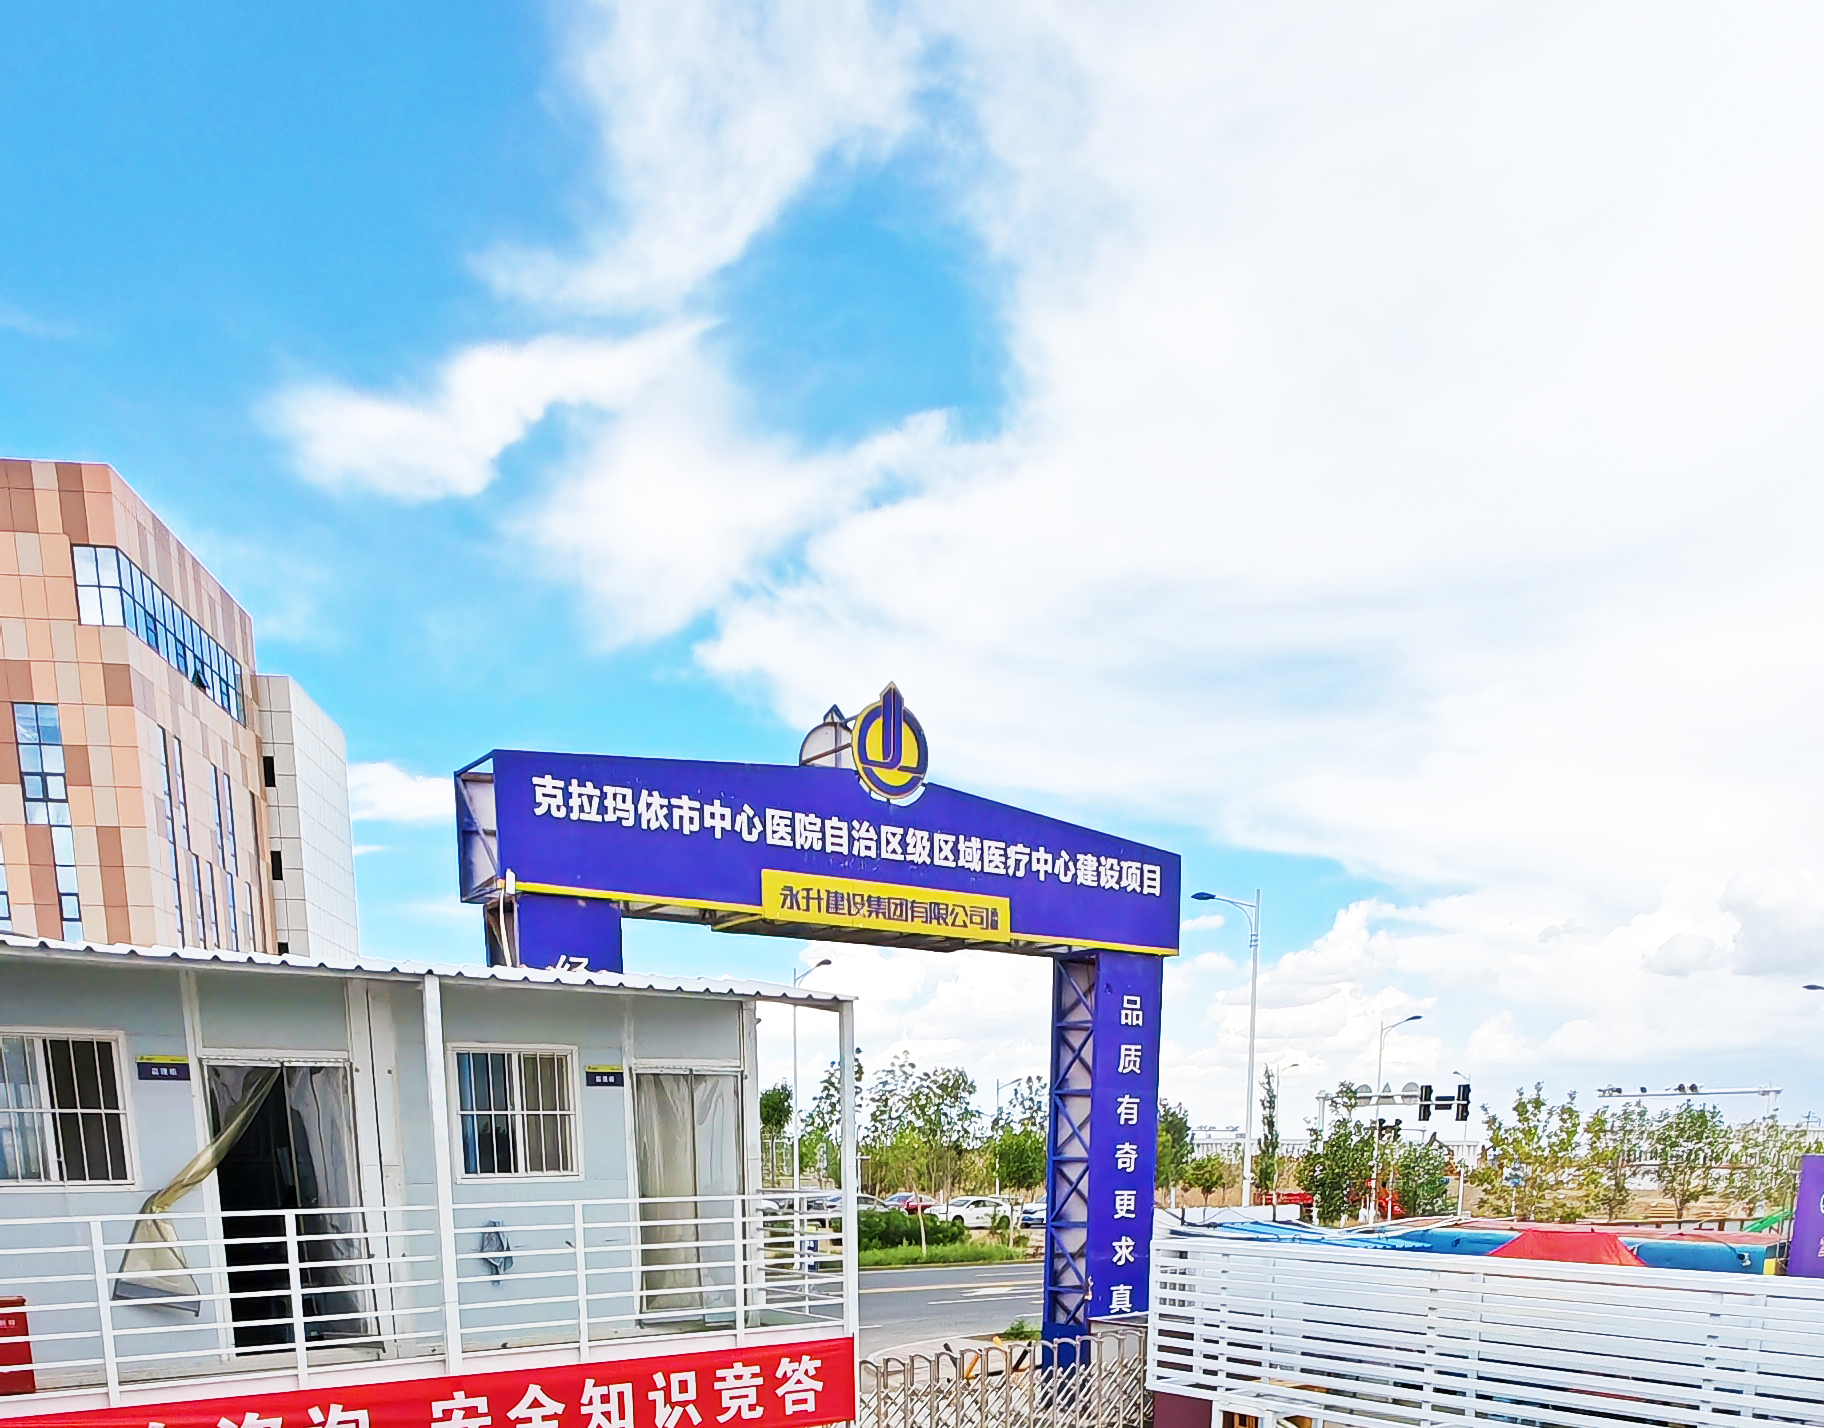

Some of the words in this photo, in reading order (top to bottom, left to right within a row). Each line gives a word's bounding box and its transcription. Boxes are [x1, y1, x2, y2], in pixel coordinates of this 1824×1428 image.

[531, 774, 1162, 897] 克拉玛依市中心医院自治区级区域医疗中心建设项目
[1109, 994, 1144, 1315] 品质有奇更求真
